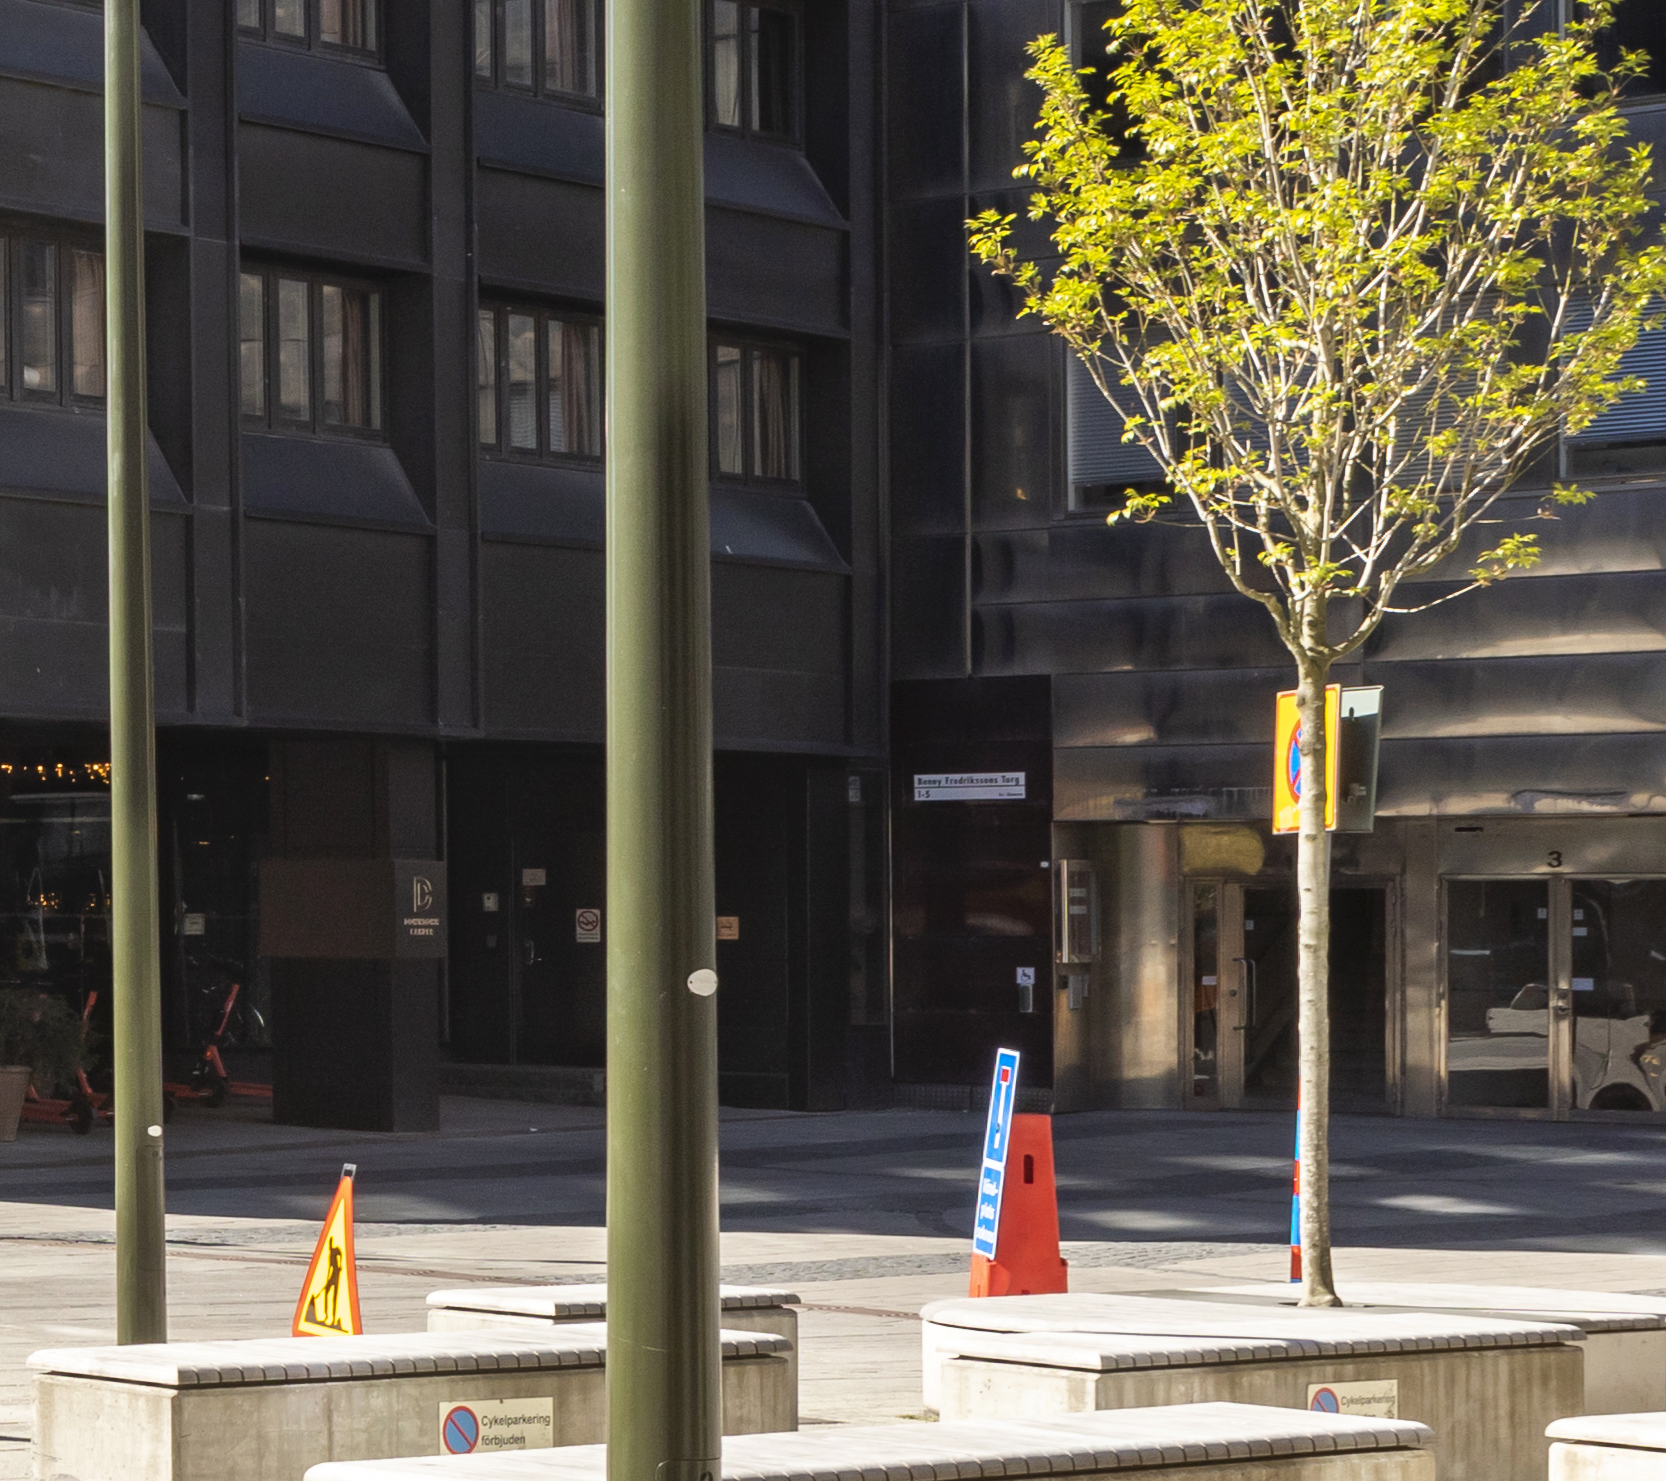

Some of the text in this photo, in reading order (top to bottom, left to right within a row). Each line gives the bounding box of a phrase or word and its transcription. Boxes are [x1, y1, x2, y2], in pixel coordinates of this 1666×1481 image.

[944, 775, 998, 786] Fredrikssons
[1001, 775, 1020, 785] Torg
[1546, 850, 1563, 869] 3
[1340, 1393, 1396, 1408] Cykelparkering
[481, 1413, 551, 1429] Cykelparkering
[481, 1434, 526, 1448] förbjuden
